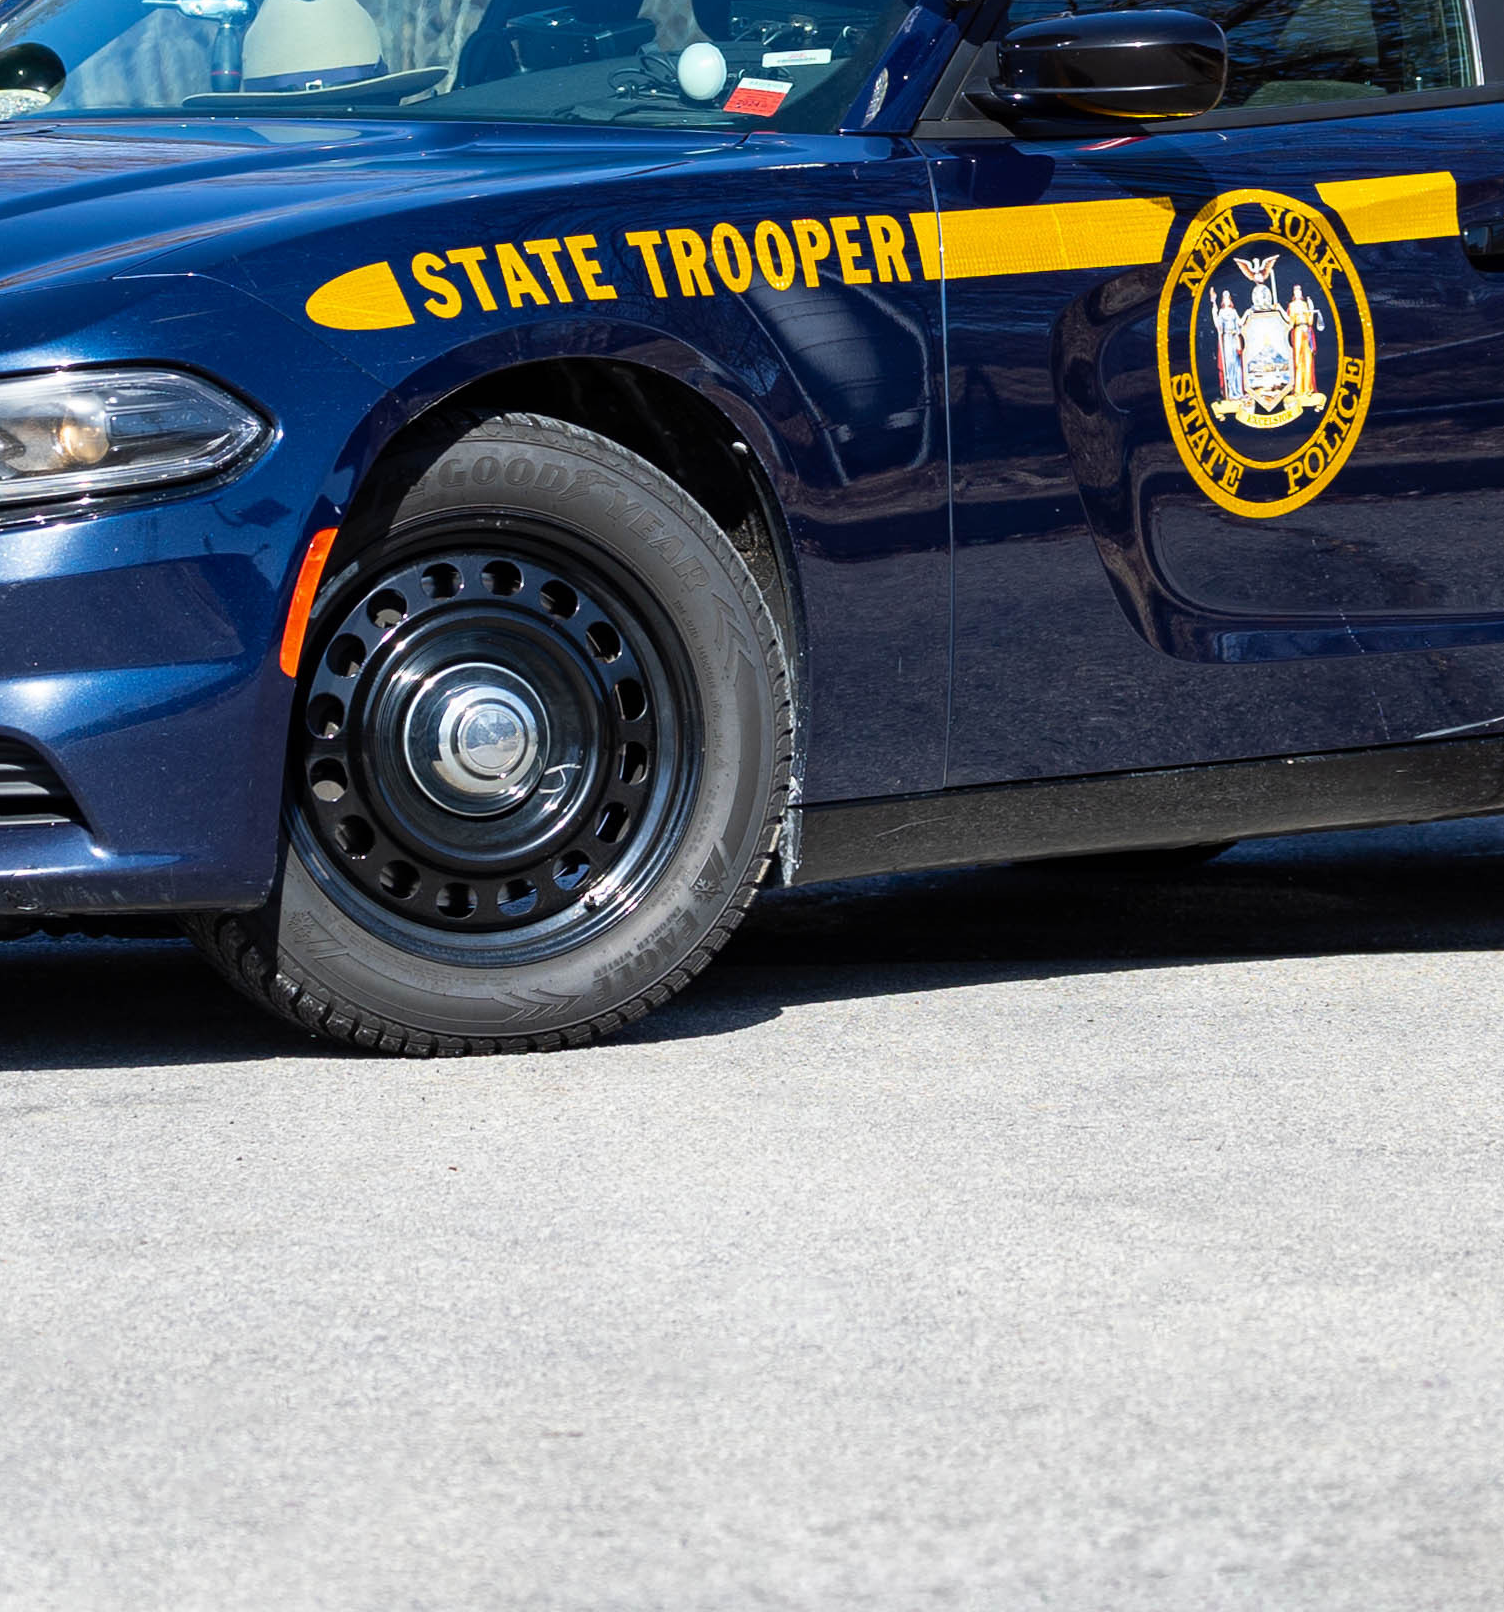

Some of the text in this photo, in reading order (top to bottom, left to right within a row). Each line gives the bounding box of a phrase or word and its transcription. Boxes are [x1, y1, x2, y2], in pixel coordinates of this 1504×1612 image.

[412, 215, 911, 319] STATE TROOPER
[1179, 202, 1343, 297] NEW YORK
[1170, 356, 1364, 495] STATE POLICE
